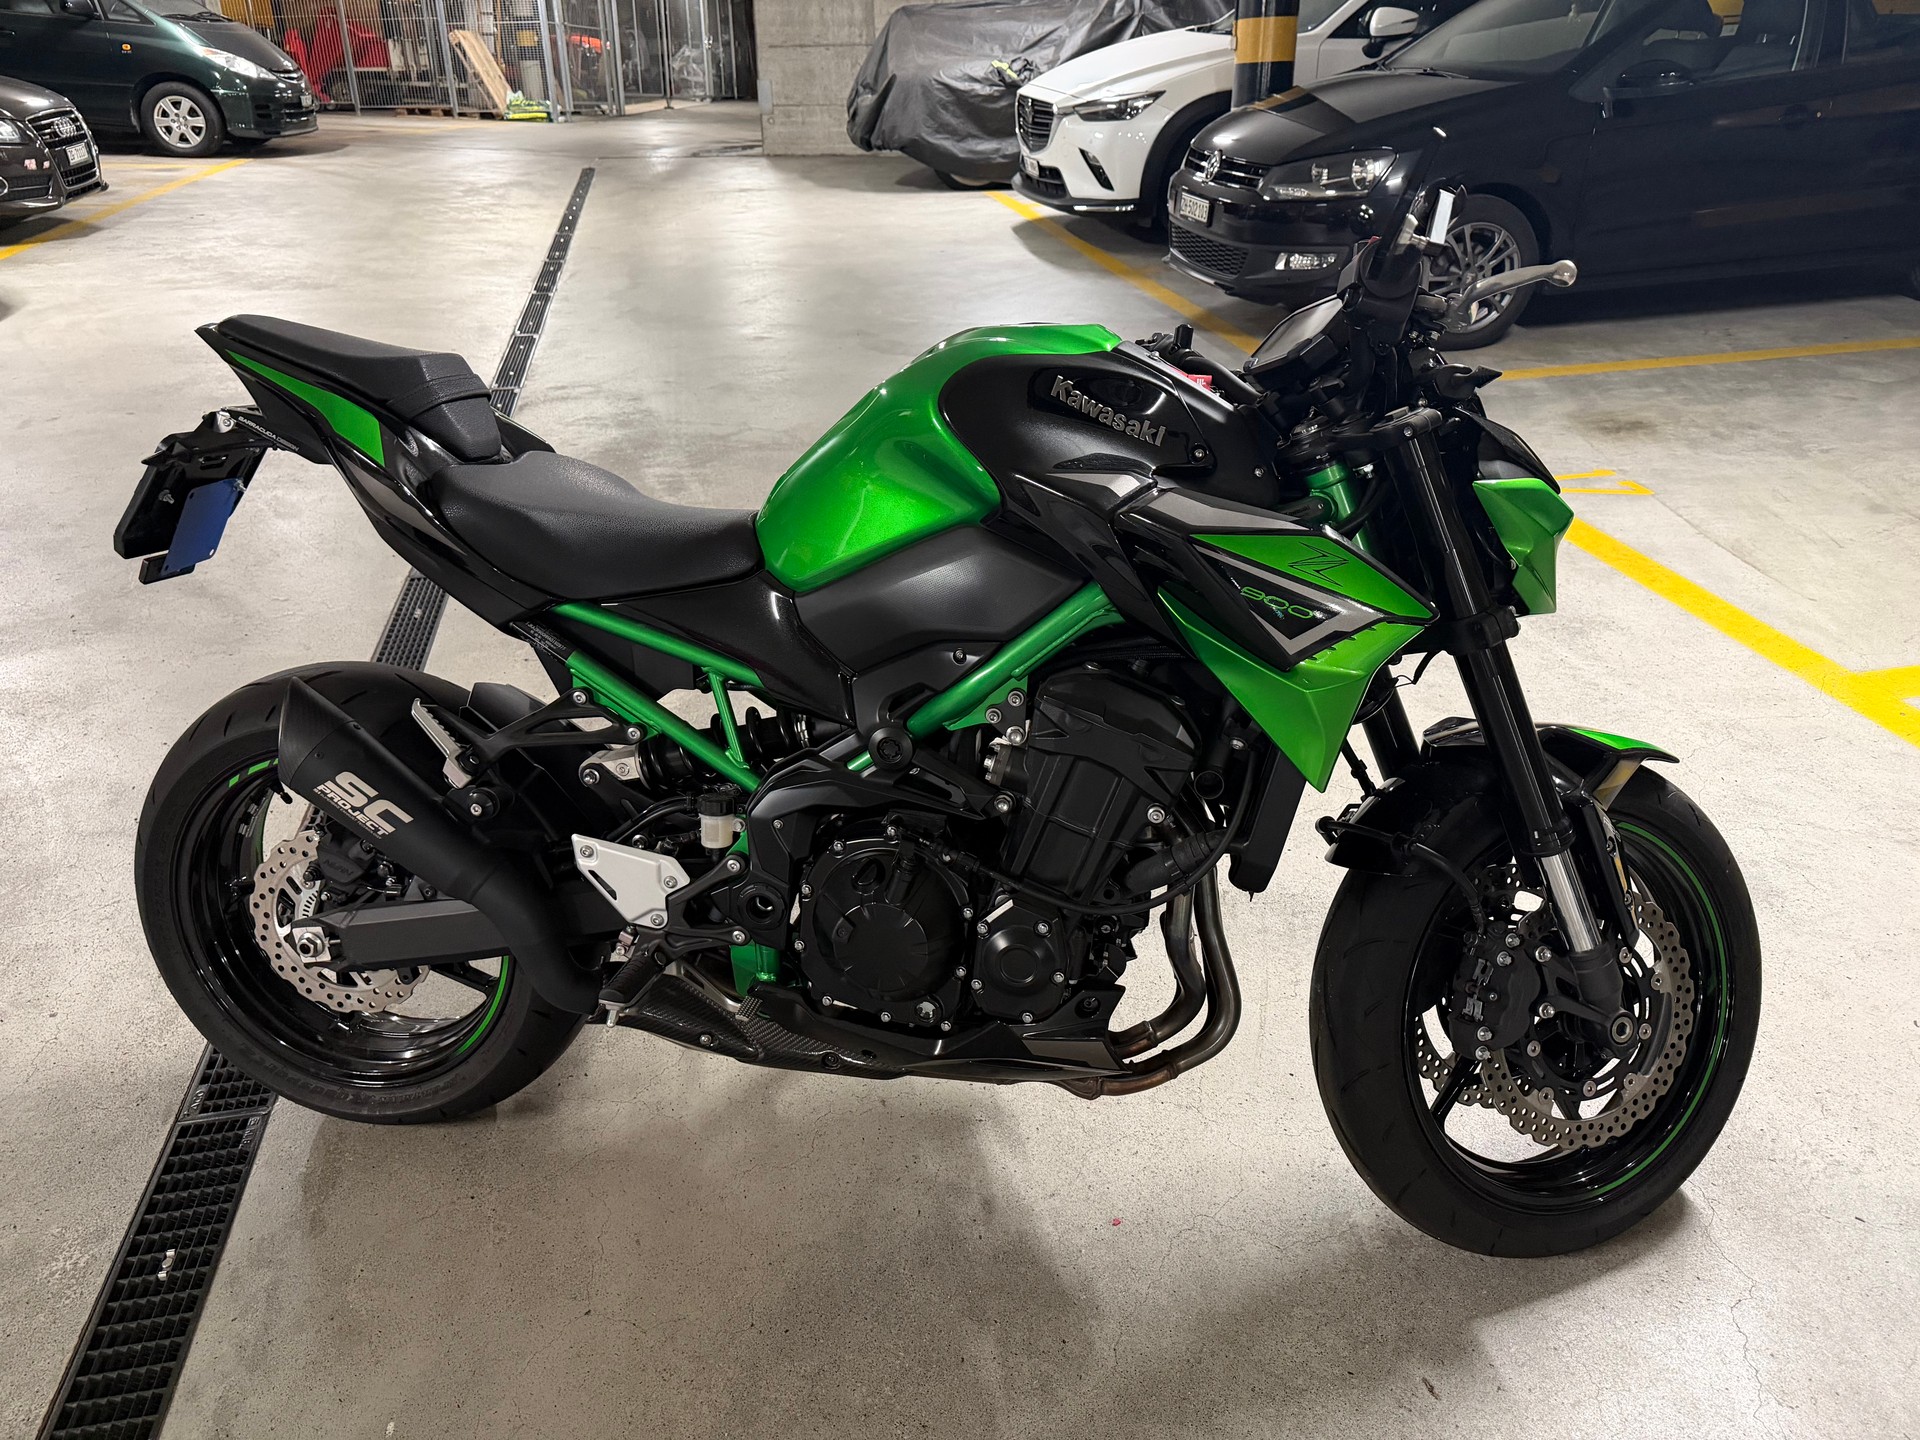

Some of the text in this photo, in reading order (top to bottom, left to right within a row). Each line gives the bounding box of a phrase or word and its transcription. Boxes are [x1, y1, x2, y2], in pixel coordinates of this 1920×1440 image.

[238, 416, 276, 440] BARRACUDA
[1051, 375, 1168, 447] Kawasaki
[1240, 586, 1314, 619] 900
[316, 784, 389, 835] PROJECT
[323, 771, 414, 834] SC
